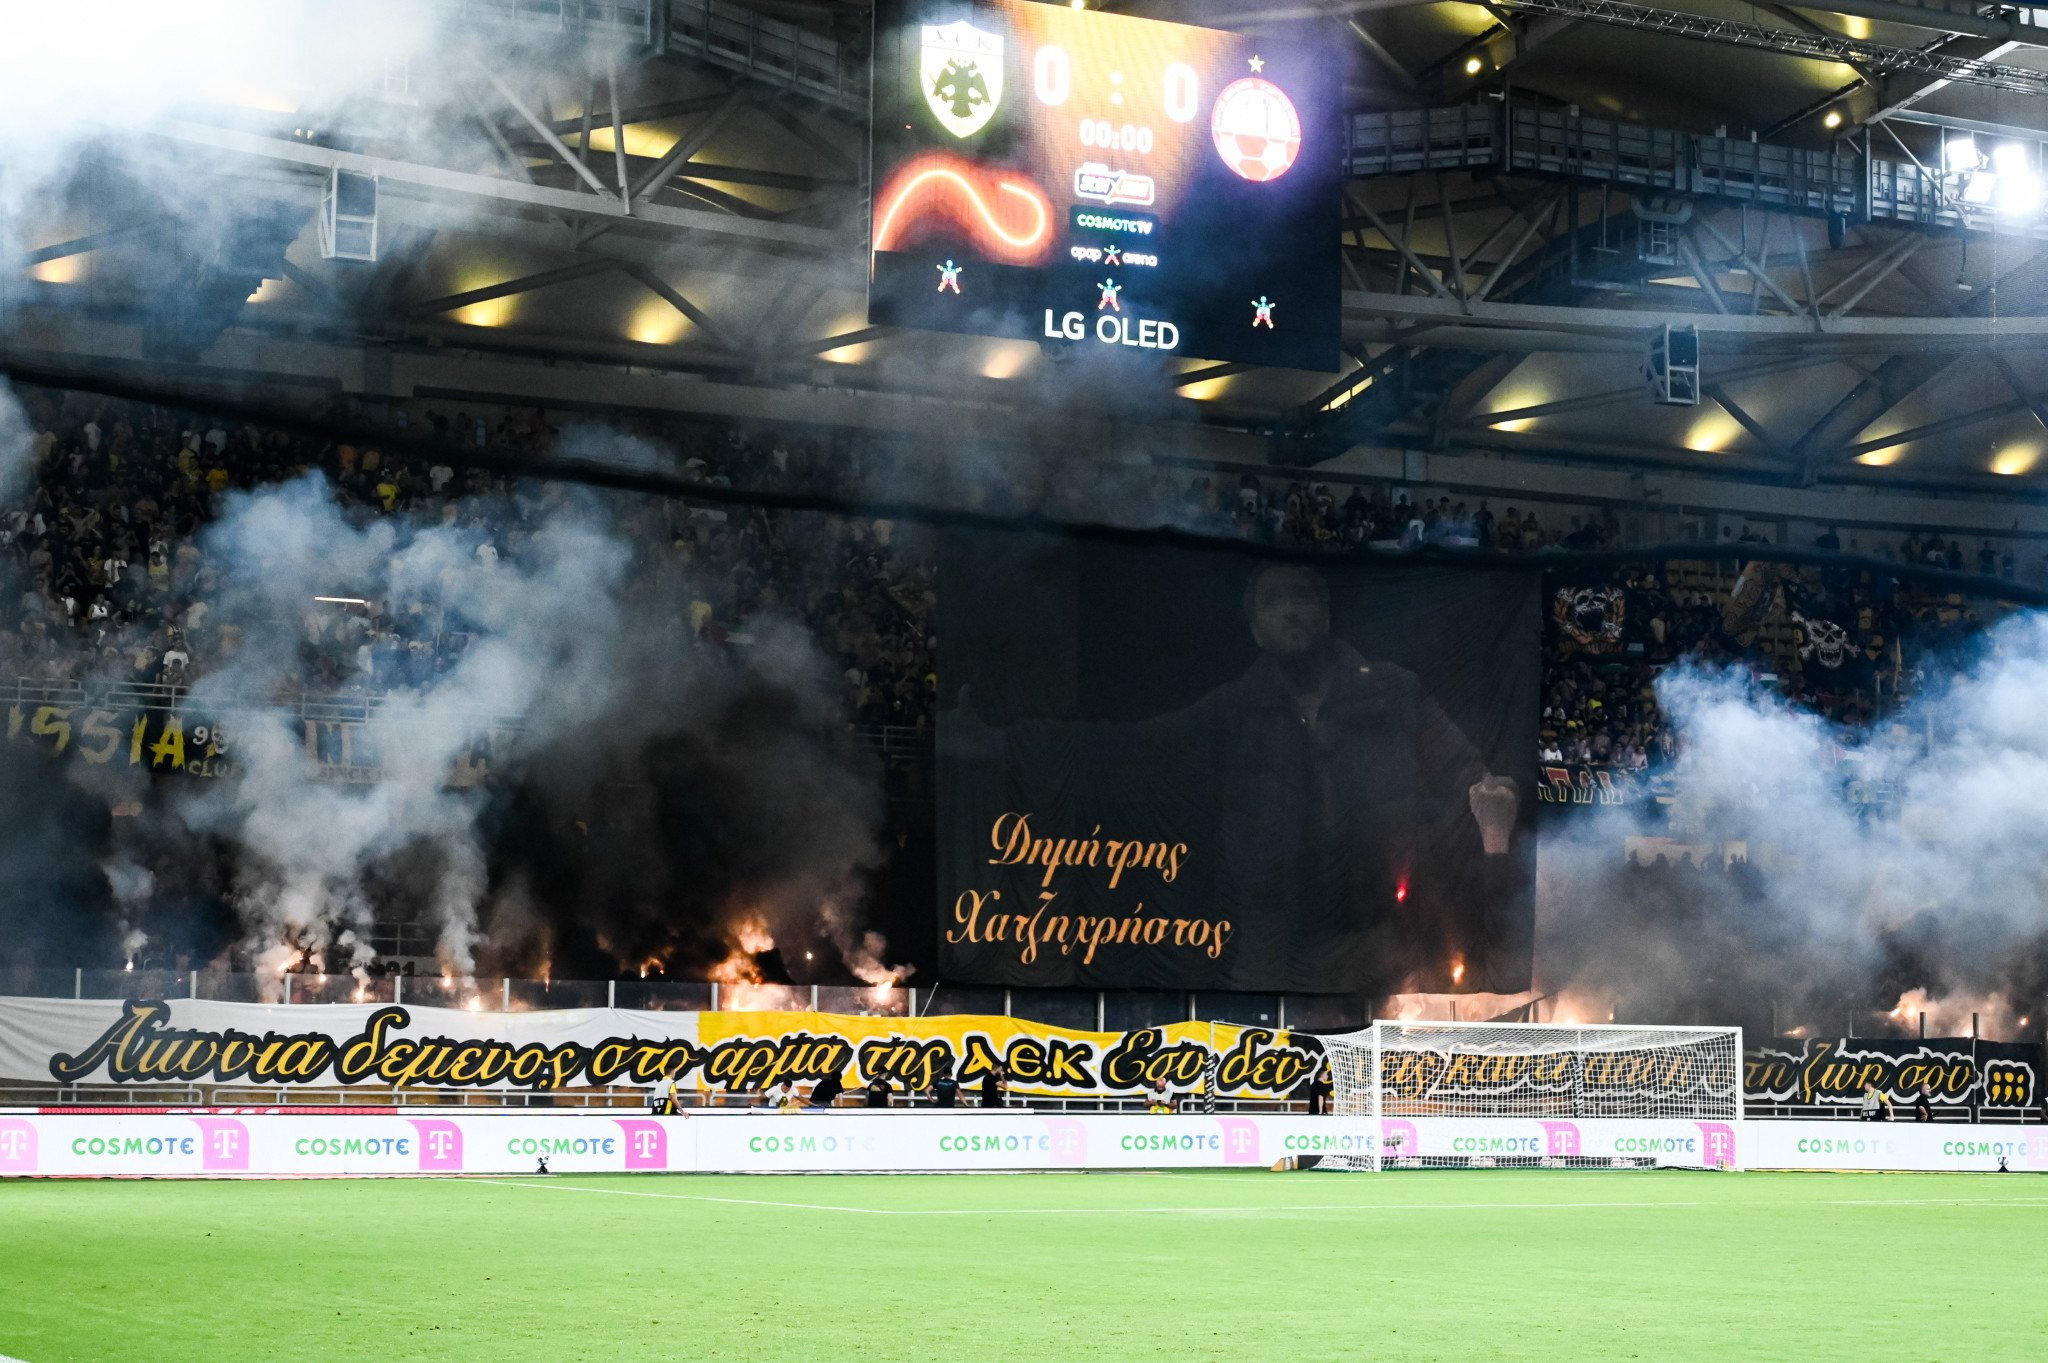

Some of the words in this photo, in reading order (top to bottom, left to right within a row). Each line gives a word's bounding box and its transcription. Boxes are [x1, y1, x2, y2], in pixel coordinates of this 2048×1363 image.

[1034, 45, 1070, 106] 0
[1164, 62, 1199, 123] 0
[1079, 118, 1153, 154] 00:00
[1070, 246, 1102, 263] opap
[1122, 252, 1158, 267] arena
[1044, 308, 1086, 341] LG
[1097, 314, 1180, 351] OLED
[72, 1137, 195, 1156] COSMOTE
[213, 1129, 239, 1159] T
[295, 1138, 410, 1156] COSMOTE
[428, 1130, 453, 1159] T
[507, 1137, 615, 1156] COSMOTE
[634, 1129, 657, 1159] T
[939, 1135, 1051, 1152] COSMOTE
[1121, 1134, 1220, 1151] COSMOTE
[1284, 1134, 1376, 1151] COSMOTE
[1453, 1136, 1541, 1153] COSMOTE
[1614, 1137, 1696, 1153] COSMOTE
[1943, 1141, 2028, 1156] COSMOTE
